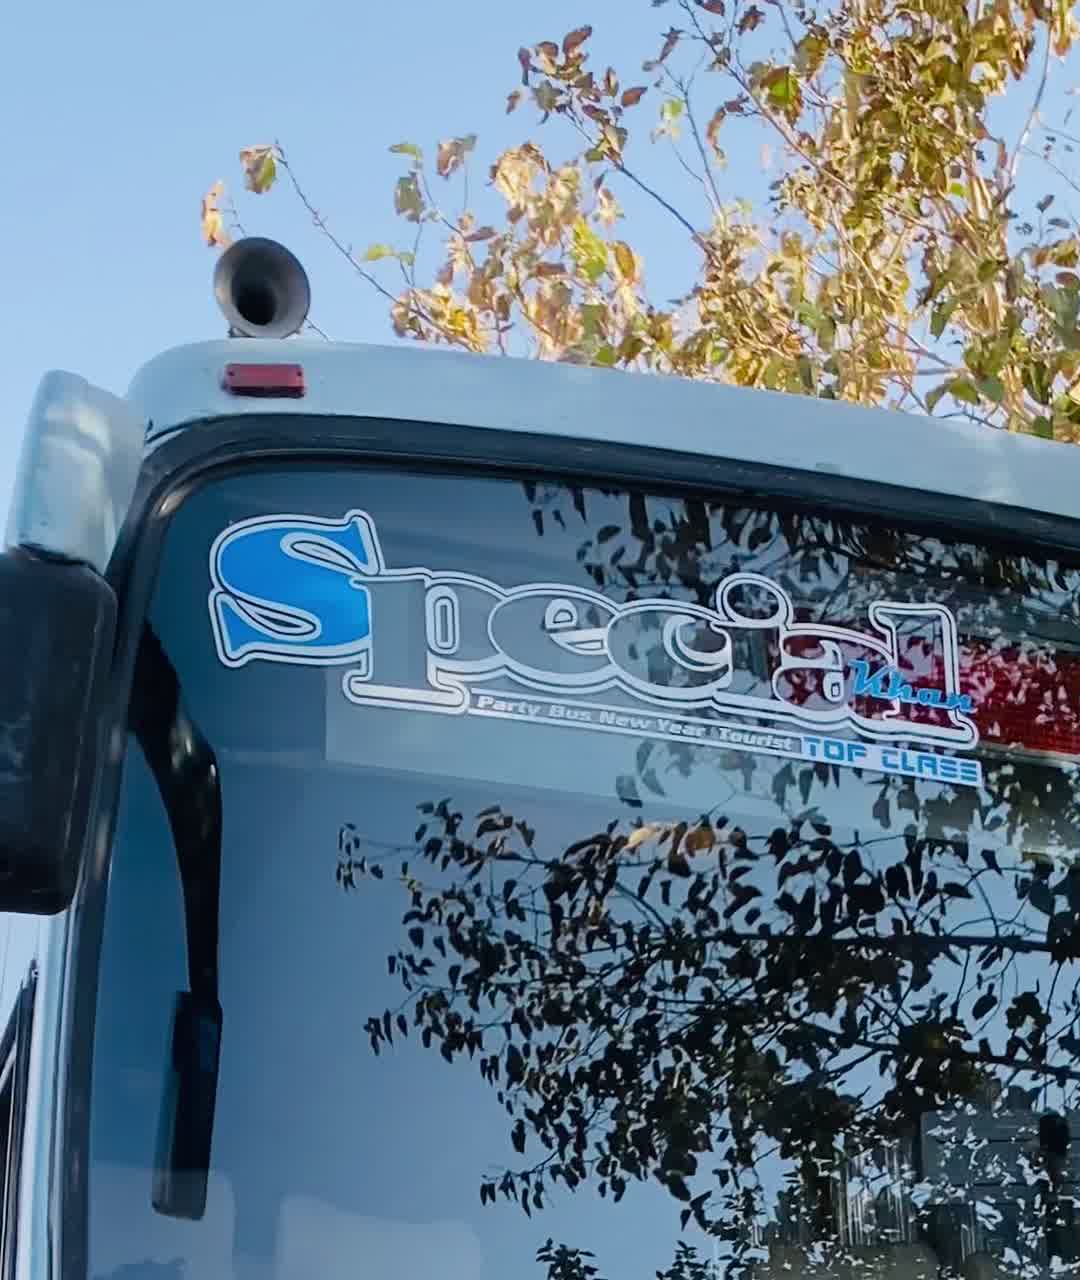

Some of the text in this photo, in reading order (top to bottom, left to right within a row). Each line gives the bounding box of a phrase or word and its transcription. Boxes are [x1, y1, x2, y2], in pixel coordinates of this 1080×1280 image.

[209, 508, 980, 751] Special
[848, 657, 977, 715] Khan
[477, 694, 793, 750] Party Bus New Year Tourist
[803, 735, 977, 783] TOP CLASS
